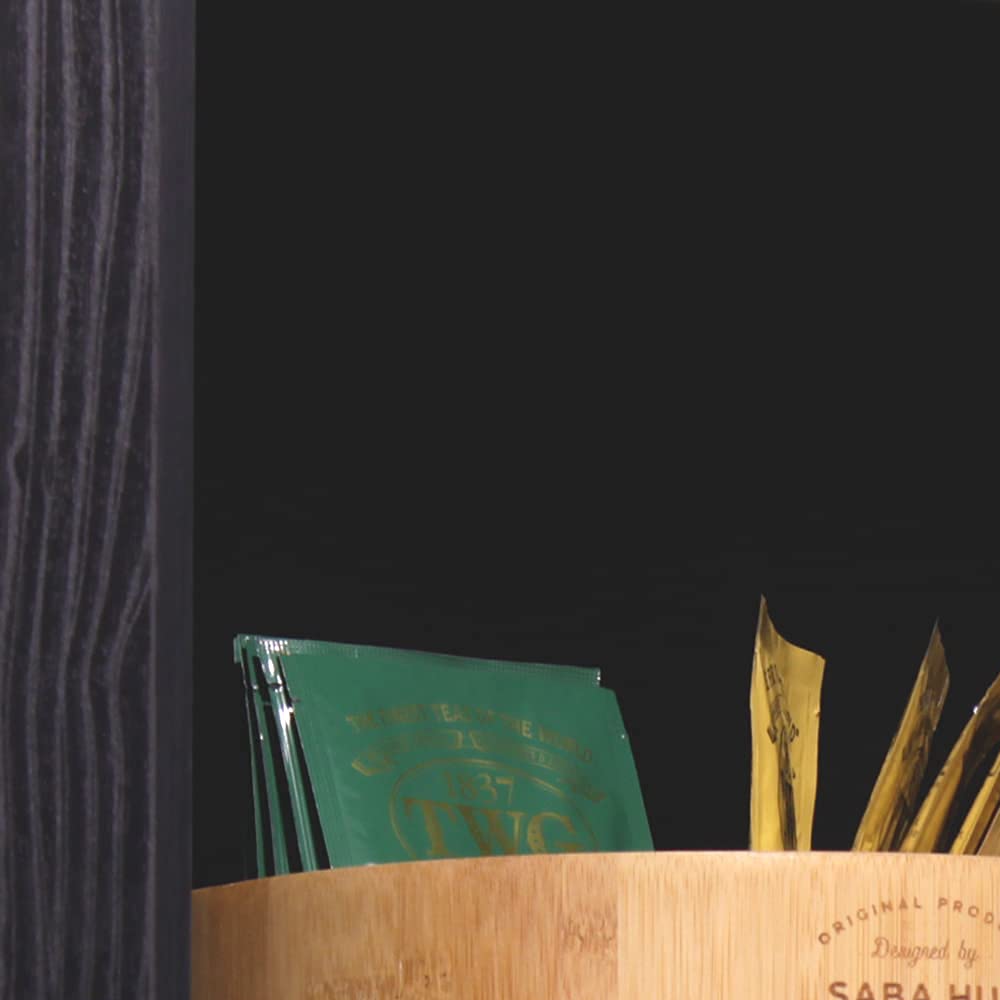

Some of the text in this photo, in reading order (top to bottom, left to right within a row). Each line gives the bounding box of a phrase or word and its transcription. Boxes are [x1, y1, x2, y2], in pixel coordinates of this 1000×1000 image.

[402, 797, 583, 857] TWG
[818, 897, 922, 945] ORIGINAL
[871, 937, 980, 968] Designed by
